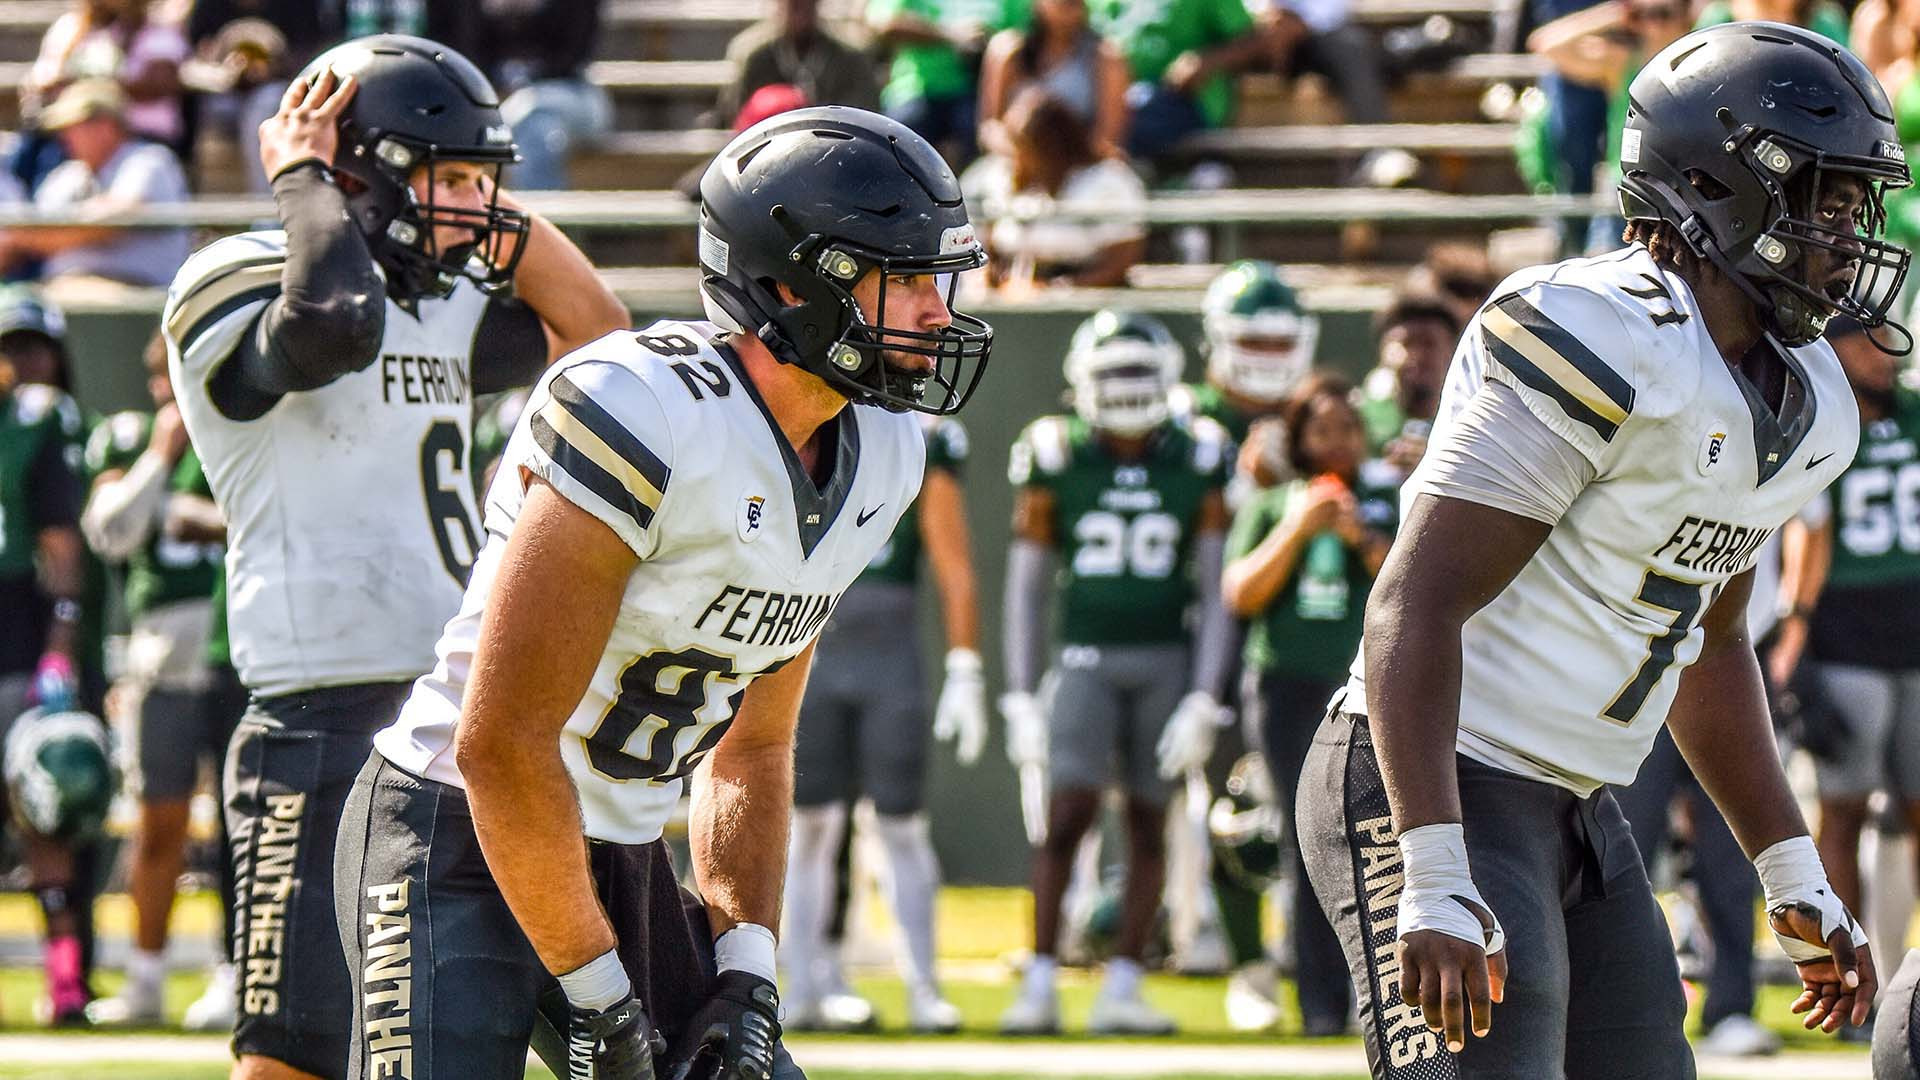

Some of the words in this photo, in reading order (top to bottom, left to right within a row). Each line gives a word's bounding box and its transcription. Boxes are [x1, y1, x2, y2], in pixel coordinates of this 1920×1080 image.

[635, 333, 731, 402] 82
[417, 415, 482, 592] 6
[1652, 514, 1775, 573] FERRUM
[694, 584, 842, 647] FERRUM
[1597, 567, 1722, 728] 7
[244, 791, 306, 1017] PANTHERS
[364, 878, 413, 1080] PANTHE
